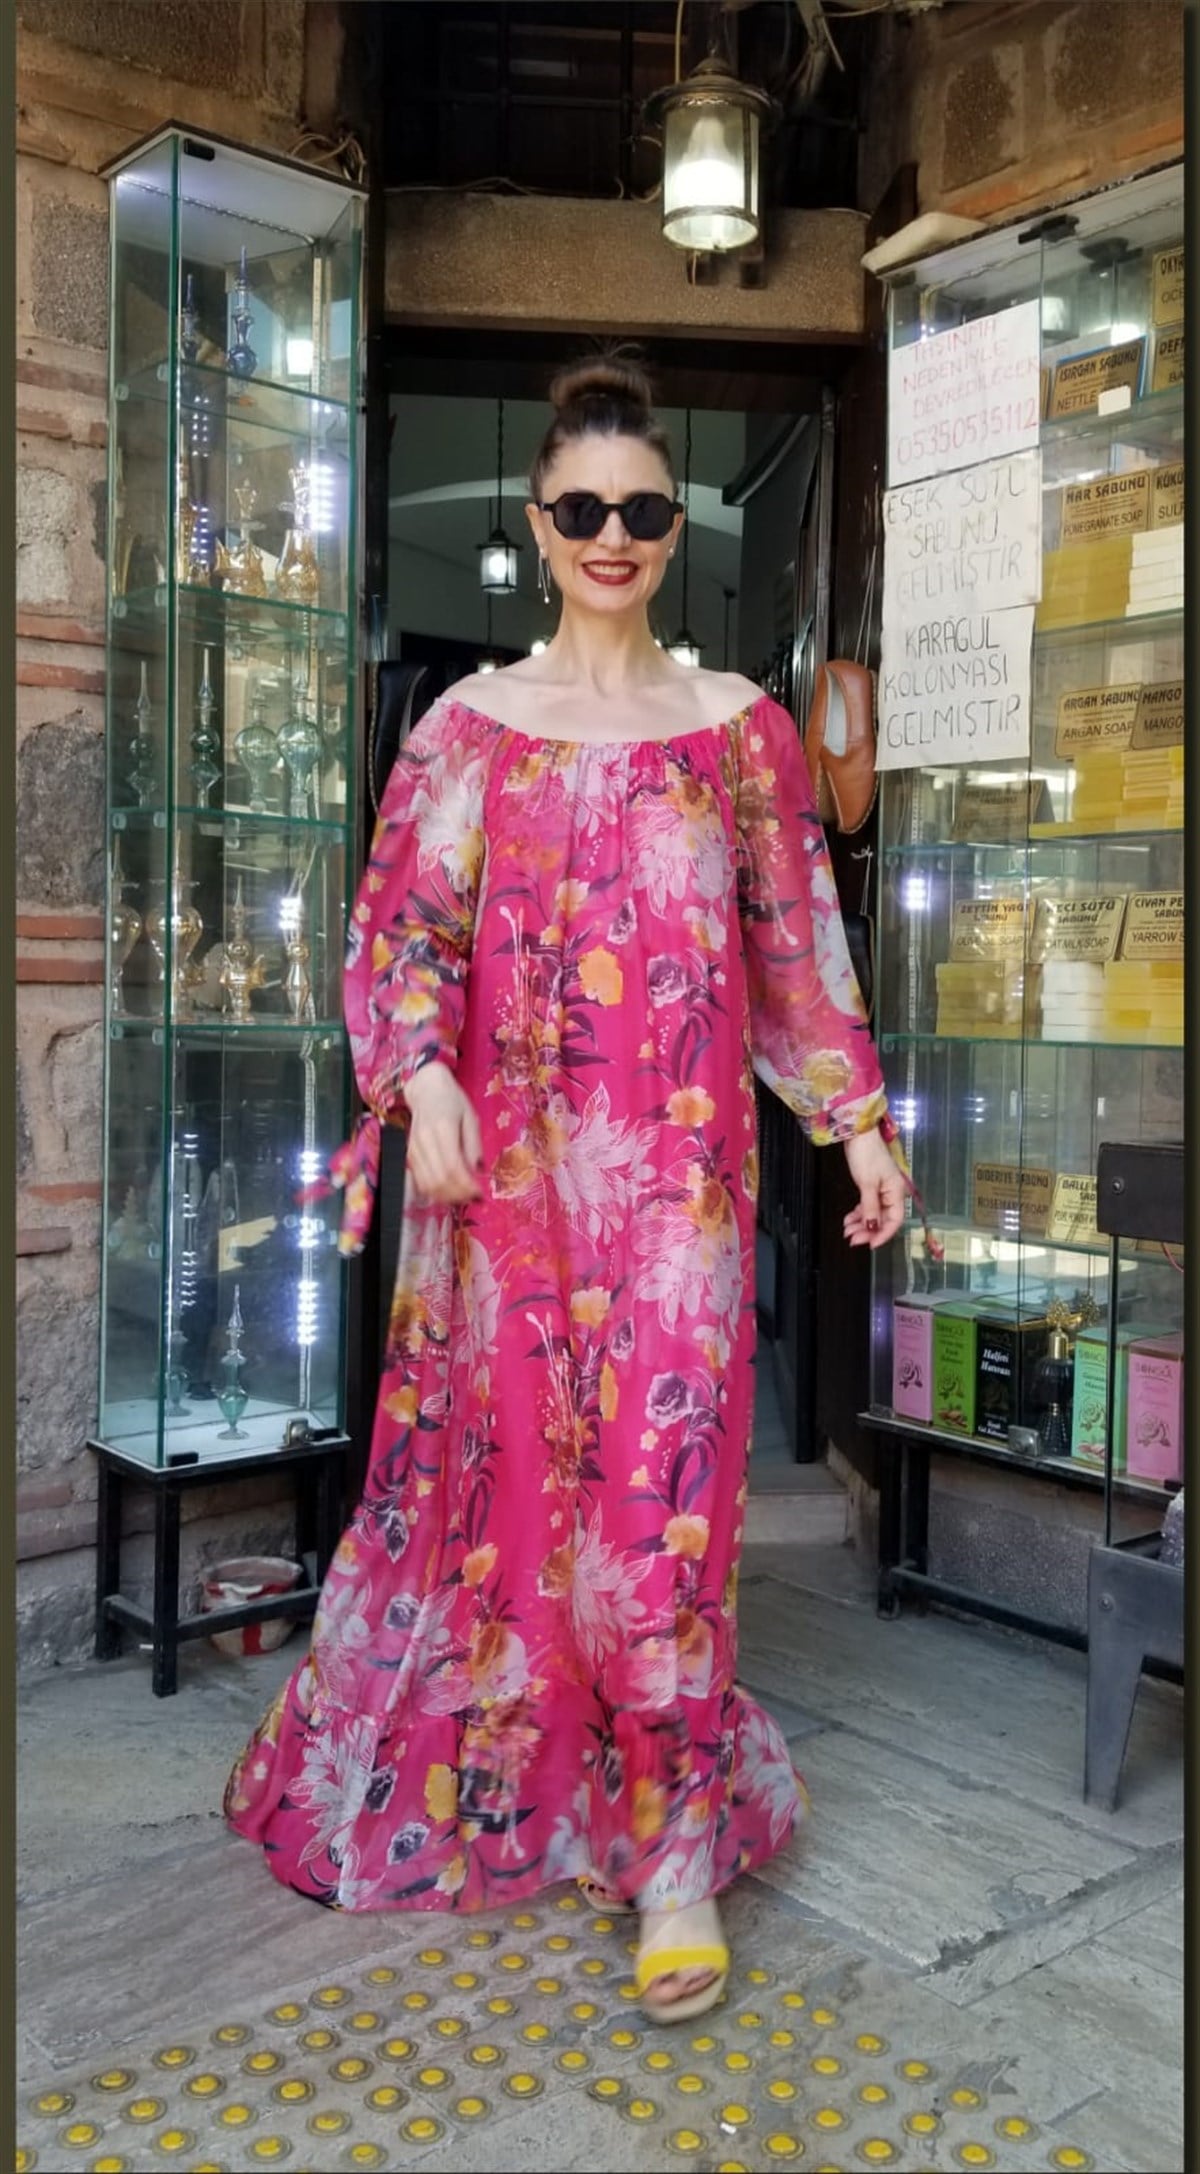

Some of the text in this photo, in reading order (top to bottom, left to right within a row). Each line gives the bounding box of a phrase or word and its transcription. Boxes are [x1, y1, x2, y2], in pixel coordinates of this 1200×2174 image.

[1057, 390, 1097, 412] NETTLE
[1063, 509, 1144, 536] POMEGRANATE SOAP
[884, 653, 1008, 701] KOLONYASI
[1063, 695, 1098, 712] ARGAN
[1142, 687, 1182, 705] MANGO
[1144, 715, 1184, 731] MANGO
[1063, 725, 1102, 740] ARGAN
[1132, 931, 1177, 943] YARROW
